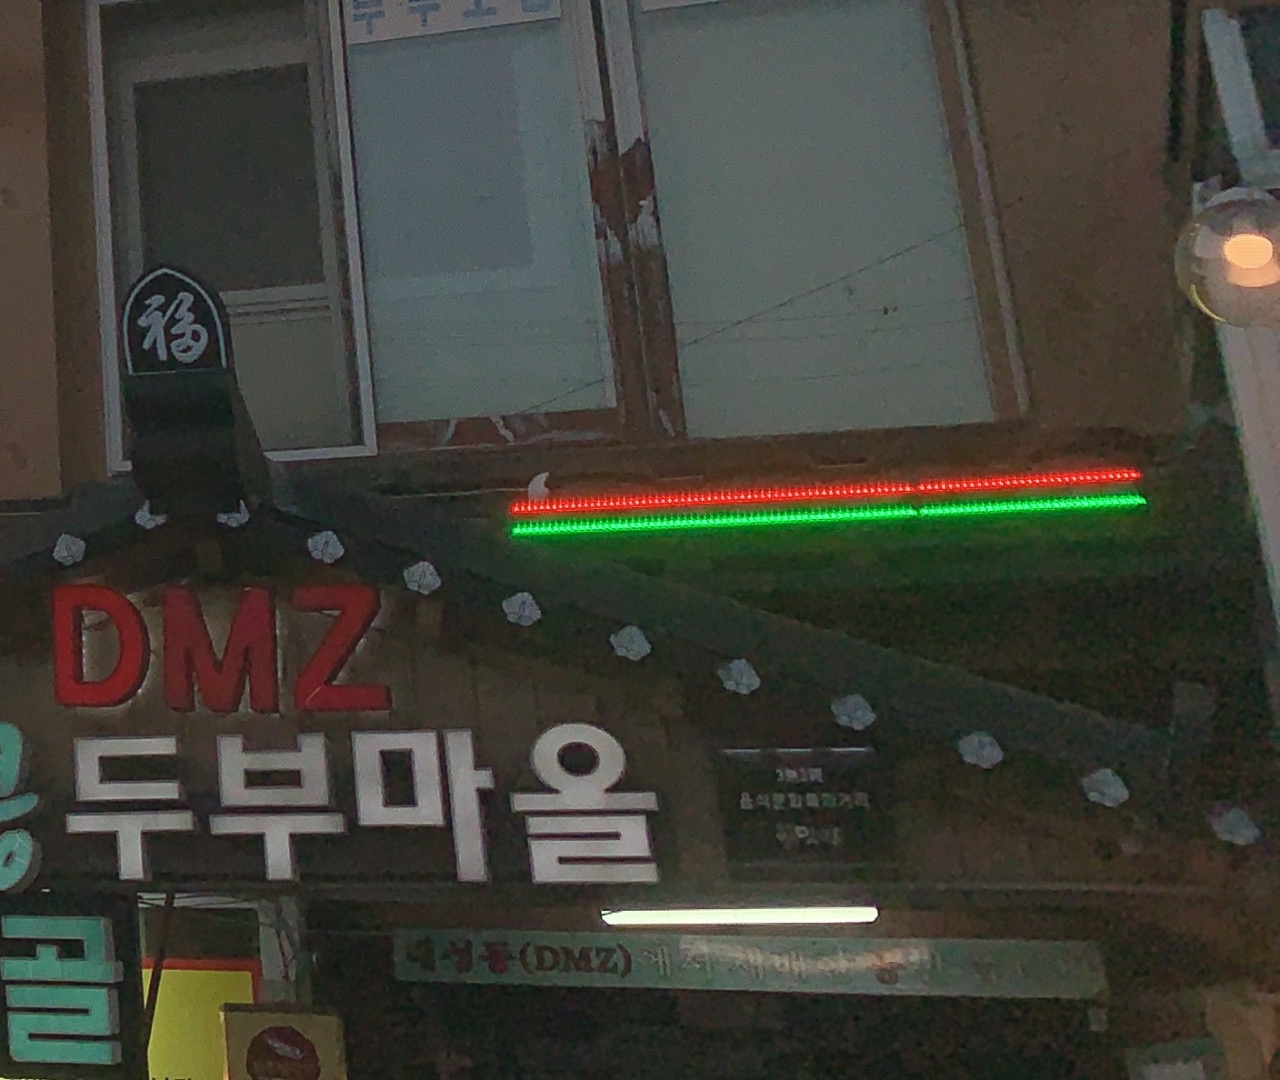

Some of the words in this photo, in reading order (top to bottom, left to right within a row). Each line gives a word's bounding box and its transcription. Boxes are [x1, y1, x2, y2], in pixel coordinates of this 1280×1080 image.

[137, 292, 209, 364] 福
[52, 583, 392, 714] DMZ
[65, 722, 660, 884] 두부마을
